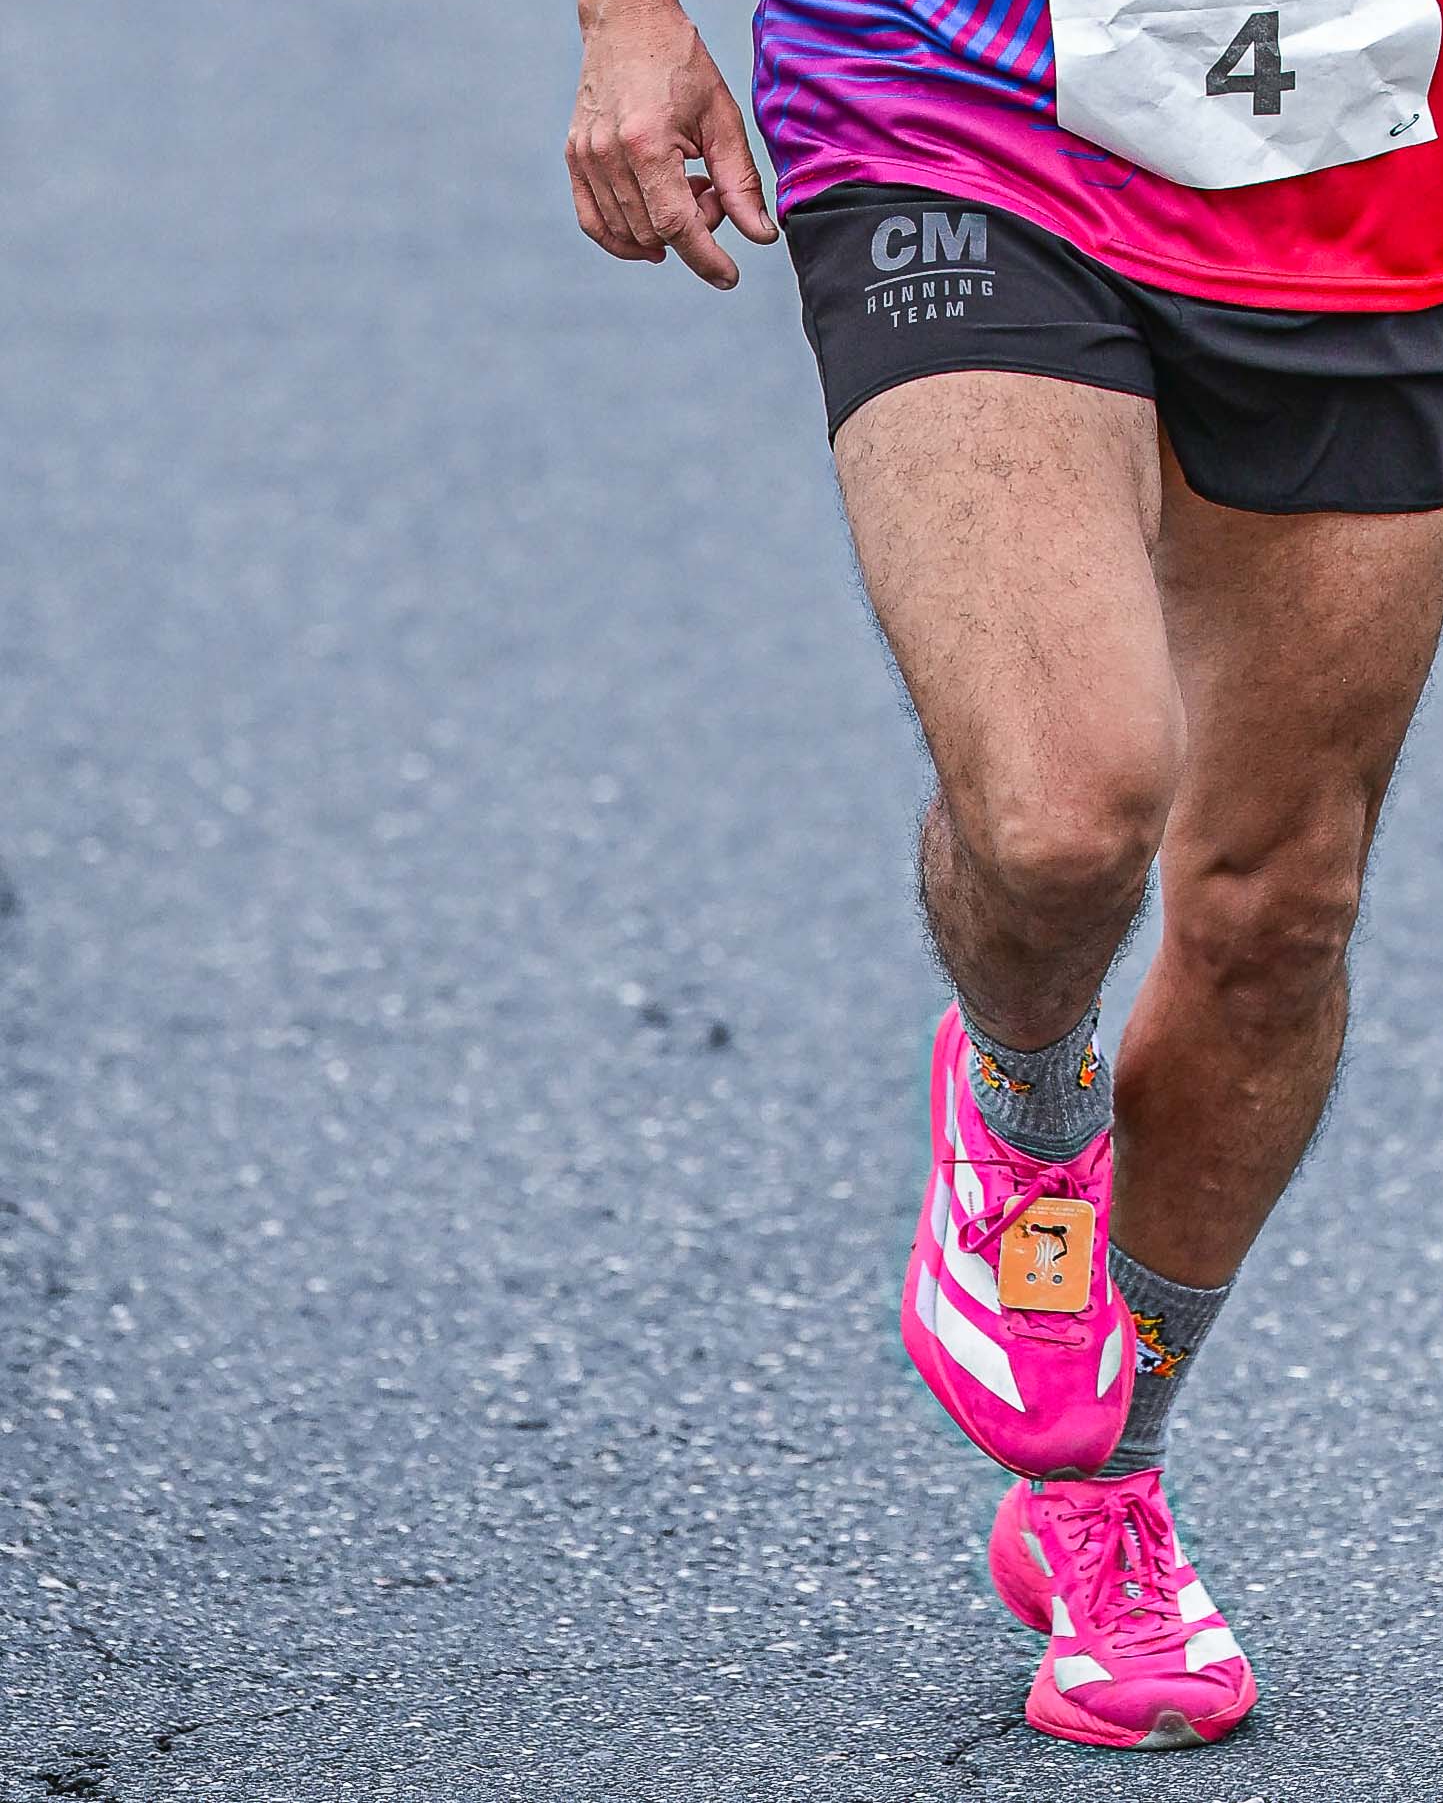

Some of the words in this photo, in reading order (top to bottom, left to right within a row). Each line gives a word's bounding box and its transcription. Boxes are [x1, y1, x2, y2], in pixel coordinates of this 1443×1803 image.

[1205, 11, 1296, 116] 4
[871, 212, 987, 271] CM
[867, 280, 993, 314] RUNNING
[890, 301, 964, 328] TEAM
